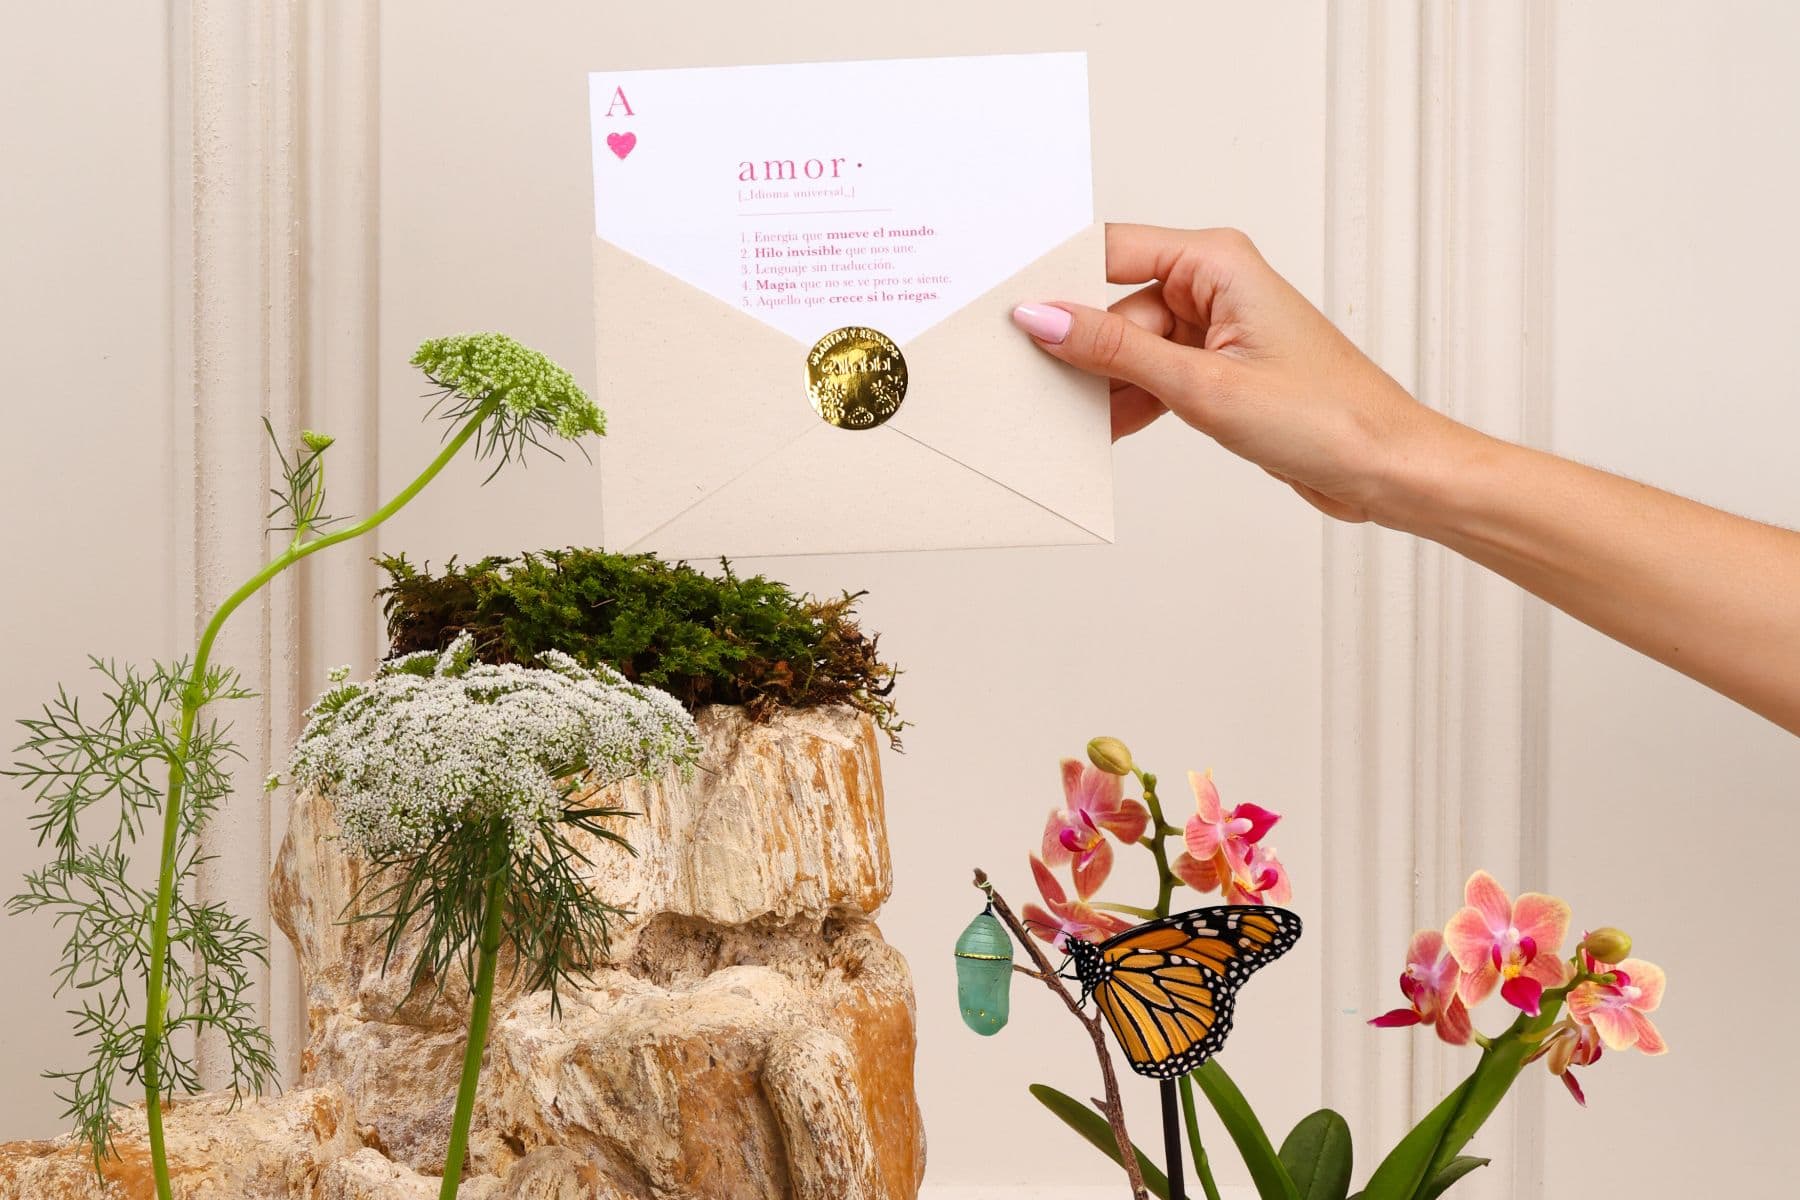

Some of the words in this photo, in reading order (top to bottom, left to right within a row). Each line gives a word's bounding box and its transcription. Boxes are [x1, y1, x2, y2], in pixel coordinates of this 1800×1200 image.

[605, 85, 635, 117] A
[741, 232, 750, 243] 1.
[802, 232, 822, 245] que
[826, 230, 869, 240] mueve
[873, 227, 884, 238] el
[740, 248, 750, 259] 2.
[755, 247, 783, 258] Hilo
[787, 245, 842, 257] invisible
[845, 246, 866, 258] que
[870, 245, 890, 255] nos
[893, 244, 917, 254] une.
[741, 265, 751, 275] 3.
[755, 263, 807, 277] Lenguaje
[811, 261, 827, 272] sin
[831, 260, 895, 271] traducción.
[742, 281, 752, 291] 4.
[756, 279, 796, 292] Magia
[800, 280, 821, 292] que
[825, 279, 840, 288] no
[843, 279, 854, 288] se
[858, 278, 870, 287] ve
[873, 276, 899, 289] pero
[902, 276, 914, 285] se
[917, 274, 952, 285] siente.
[742, 297, 752, 307] 5.
[758, 295, 801, 310] Aquello
[804, 296, 825, 308] que
[829, 294, 863, 304] crece
[867, 291, 878, 302] si
[882, 290, 894, 302] lo
